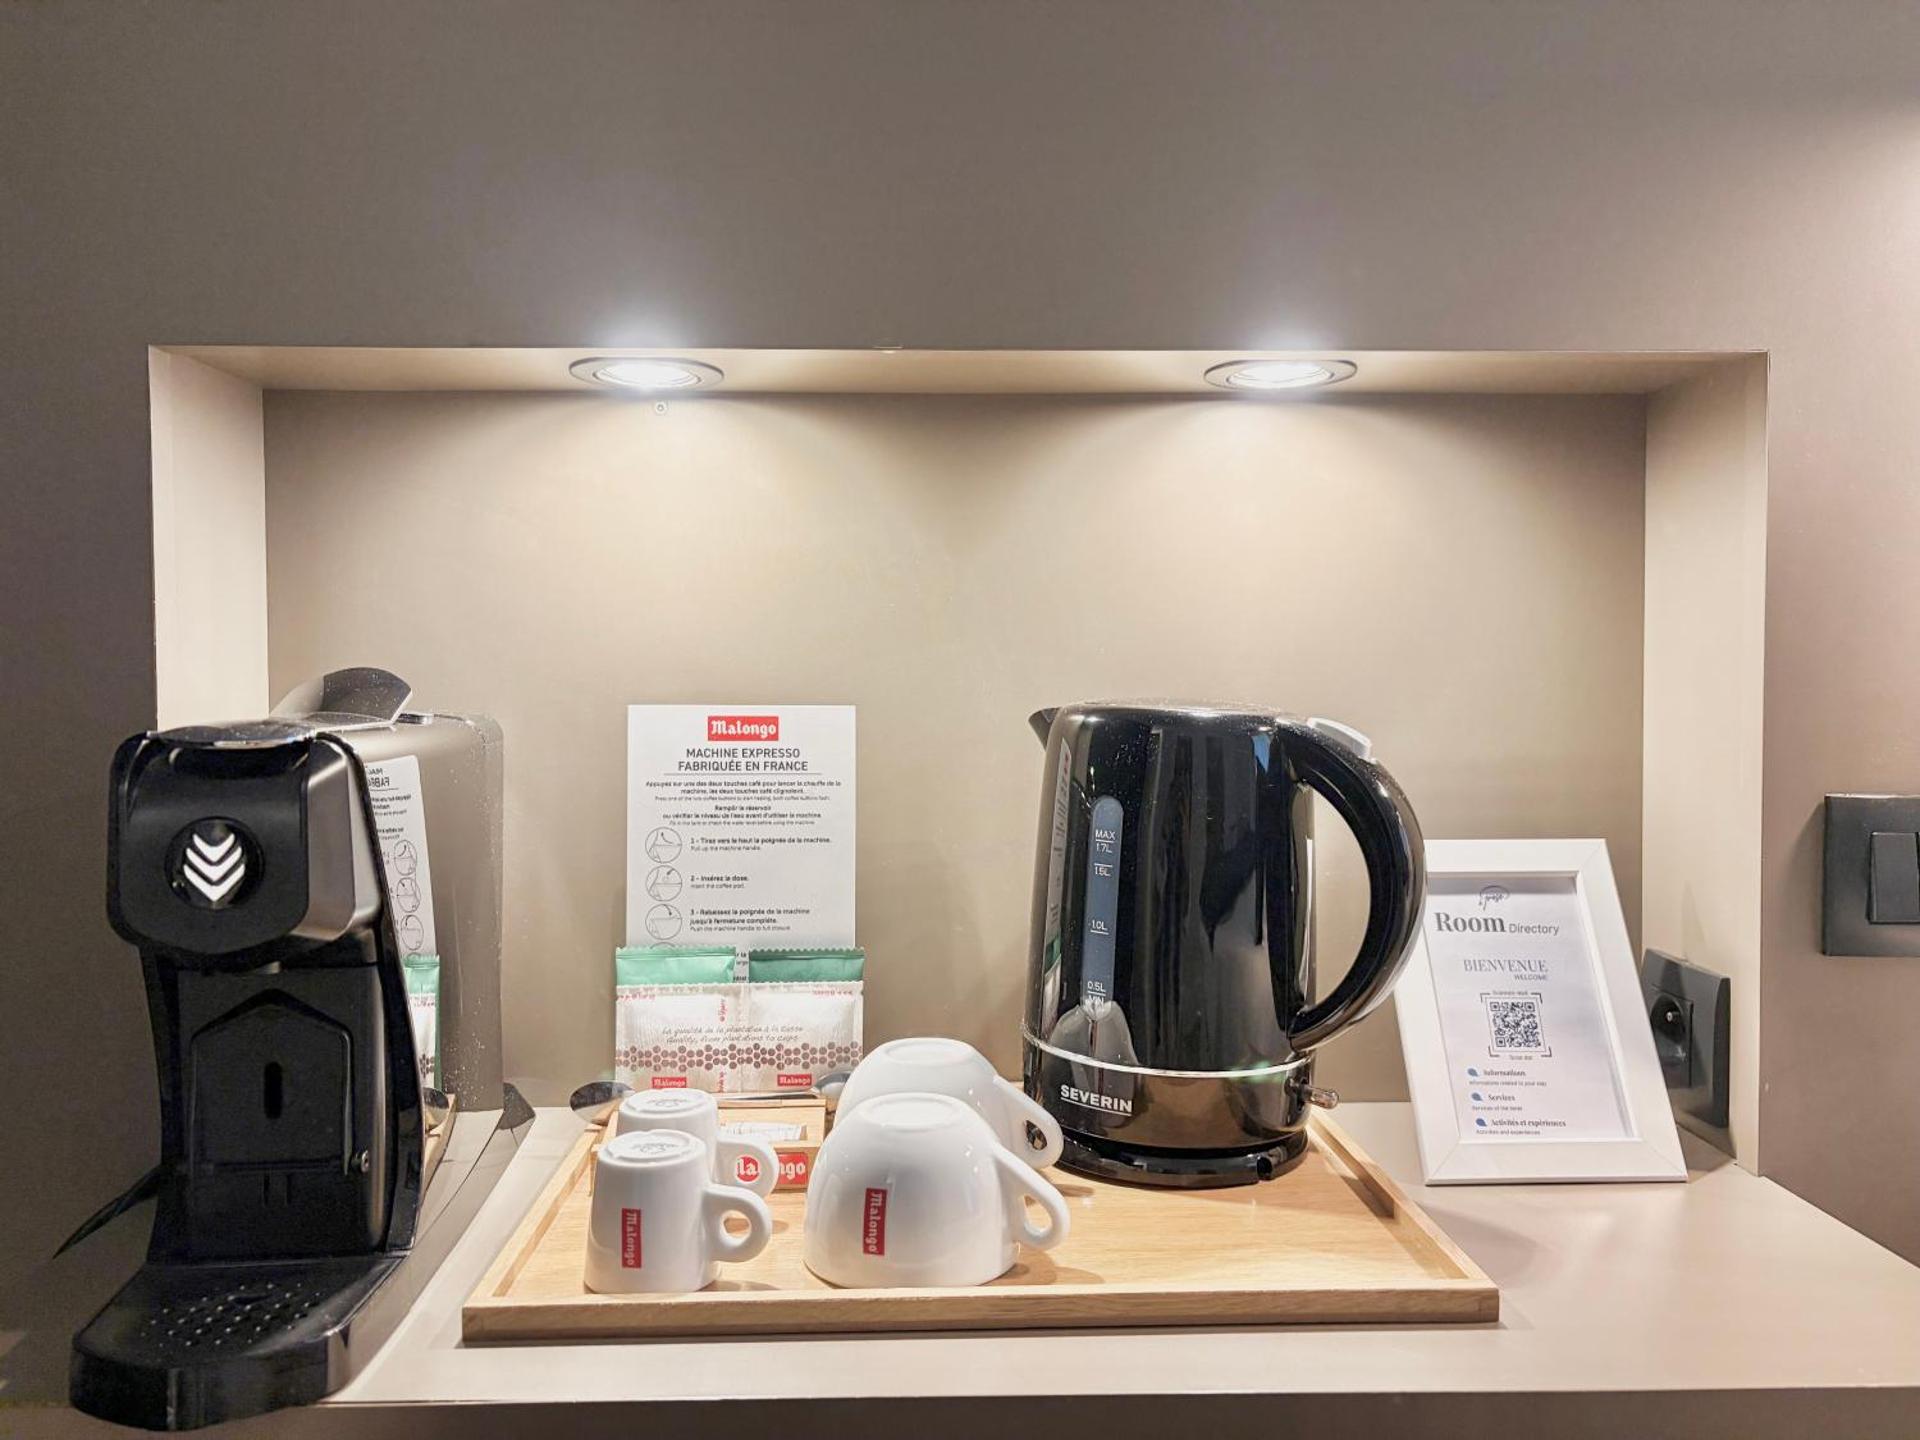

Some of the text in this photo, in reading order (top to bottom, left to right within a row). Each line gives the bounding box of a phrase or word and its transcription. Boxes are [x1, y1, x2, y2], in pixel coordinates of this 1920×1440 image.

[711, 719, 777, 739] Malongo
[686, 748, 800, 758] MACHINE EXPRESSO
[679, 759, 808, 771] FABRIQUÉE EN FRANCE
[1095, 829, 1115, 840] MAX
[1434, 912, 1560, 936] Room Directory
[1464, 959, 1548, 972] BIENVENUE
[1514, 974, 1547, 982] WELCOME
[1060, 1084, 1133, 1113] SEVERIN
[1488, 1094, 1516, 1102] Services
[867, 1191, 883, 1254] Malongo
[626, 1210, 637, 1266] Malongo
